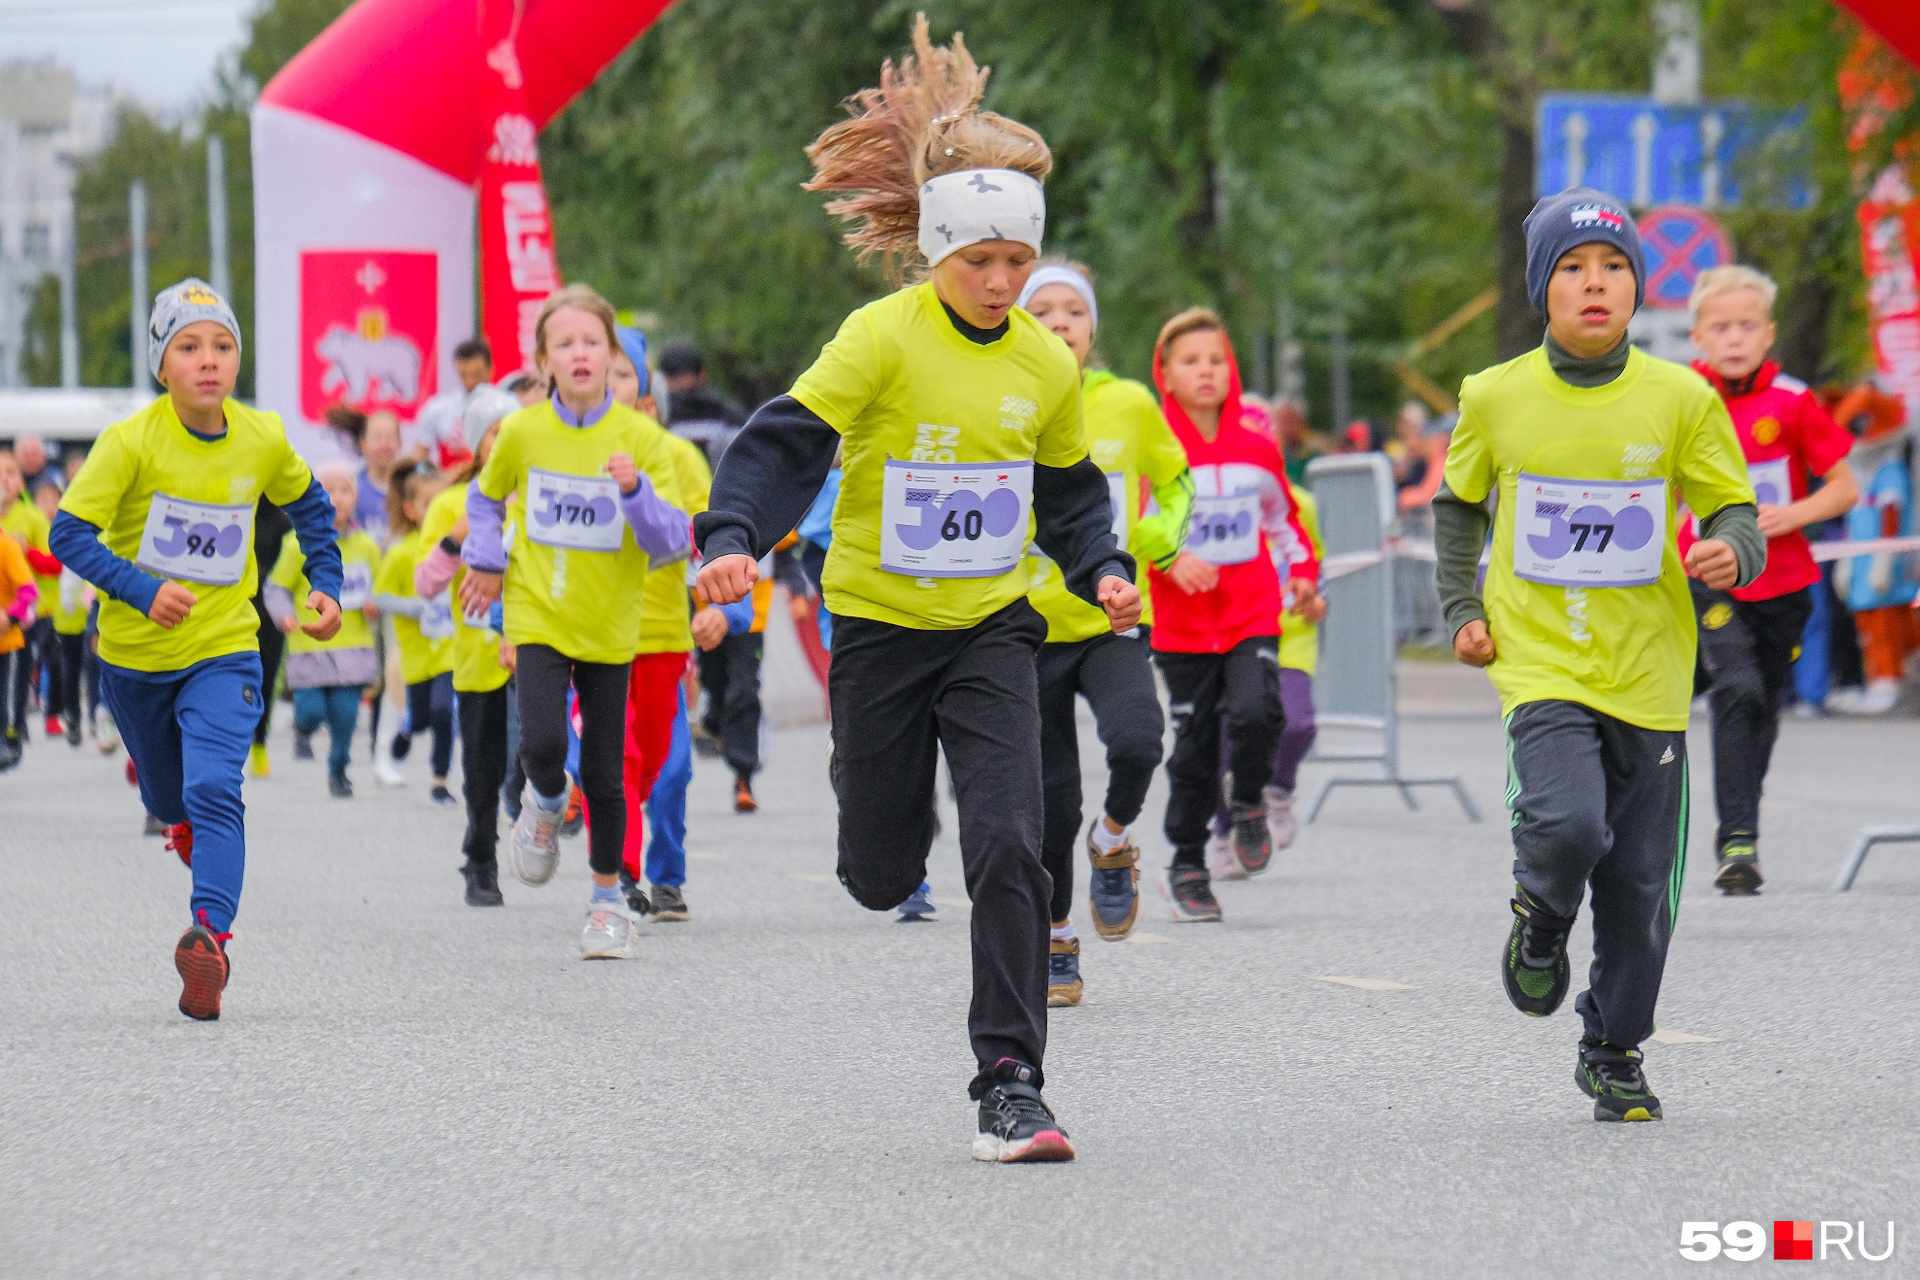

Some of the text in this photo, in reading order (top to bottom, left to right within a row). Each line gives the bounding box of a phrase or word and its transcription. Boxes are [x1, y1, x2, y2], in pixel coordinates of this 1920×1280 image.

[554, 504, 596, 526] 170
[941, 510, 983, 541] 60
[187, 533, 217, 559] 96
[1569, 523, 1615, 553] 77
